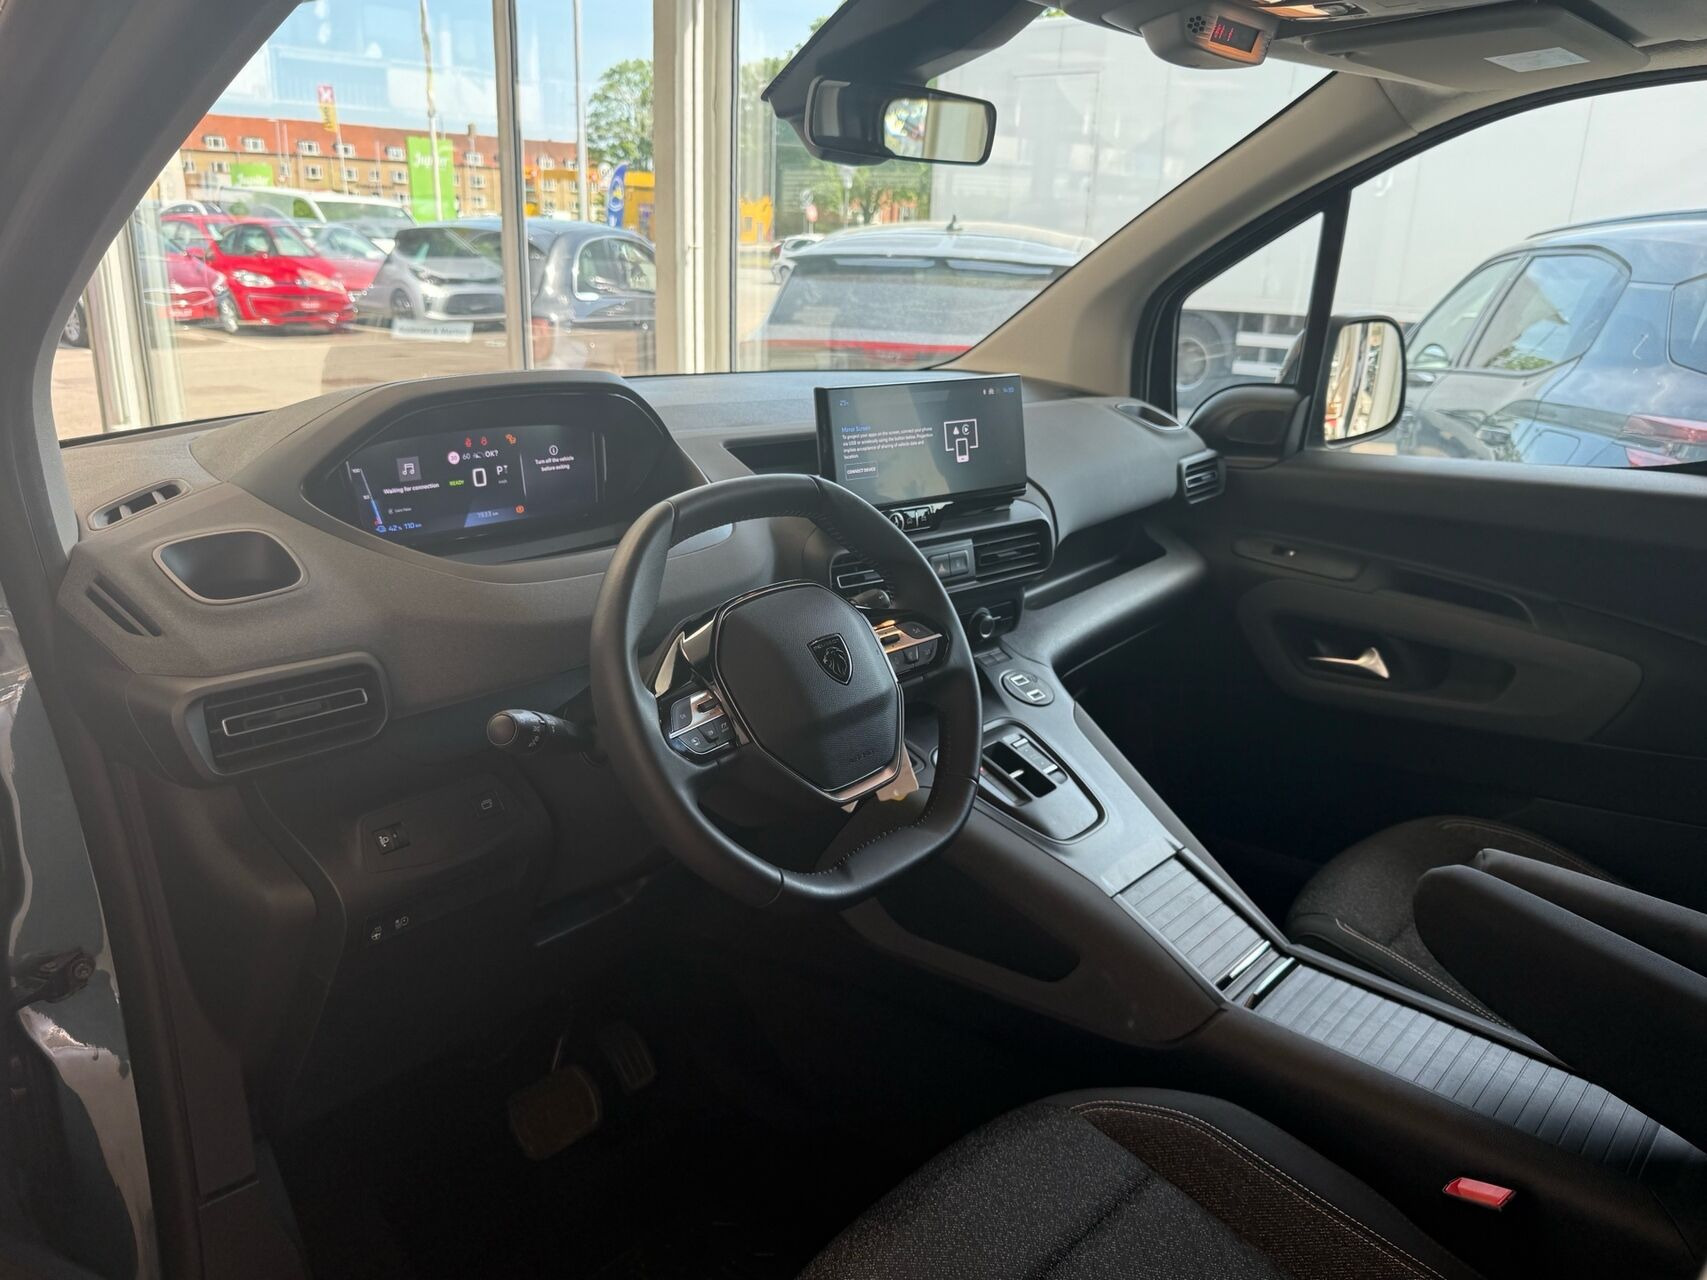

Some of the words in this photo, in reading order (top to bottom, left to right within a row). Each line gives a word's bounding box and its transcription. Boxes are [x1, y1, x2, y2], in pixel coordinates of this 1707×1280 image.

[462, 452, 471, 460] 60
[485, 449, 499, 458] OK?
[472, 468, 487, 487] 0
[496, 465, 503, 475] P
[412, 482, 440, 491] connection
